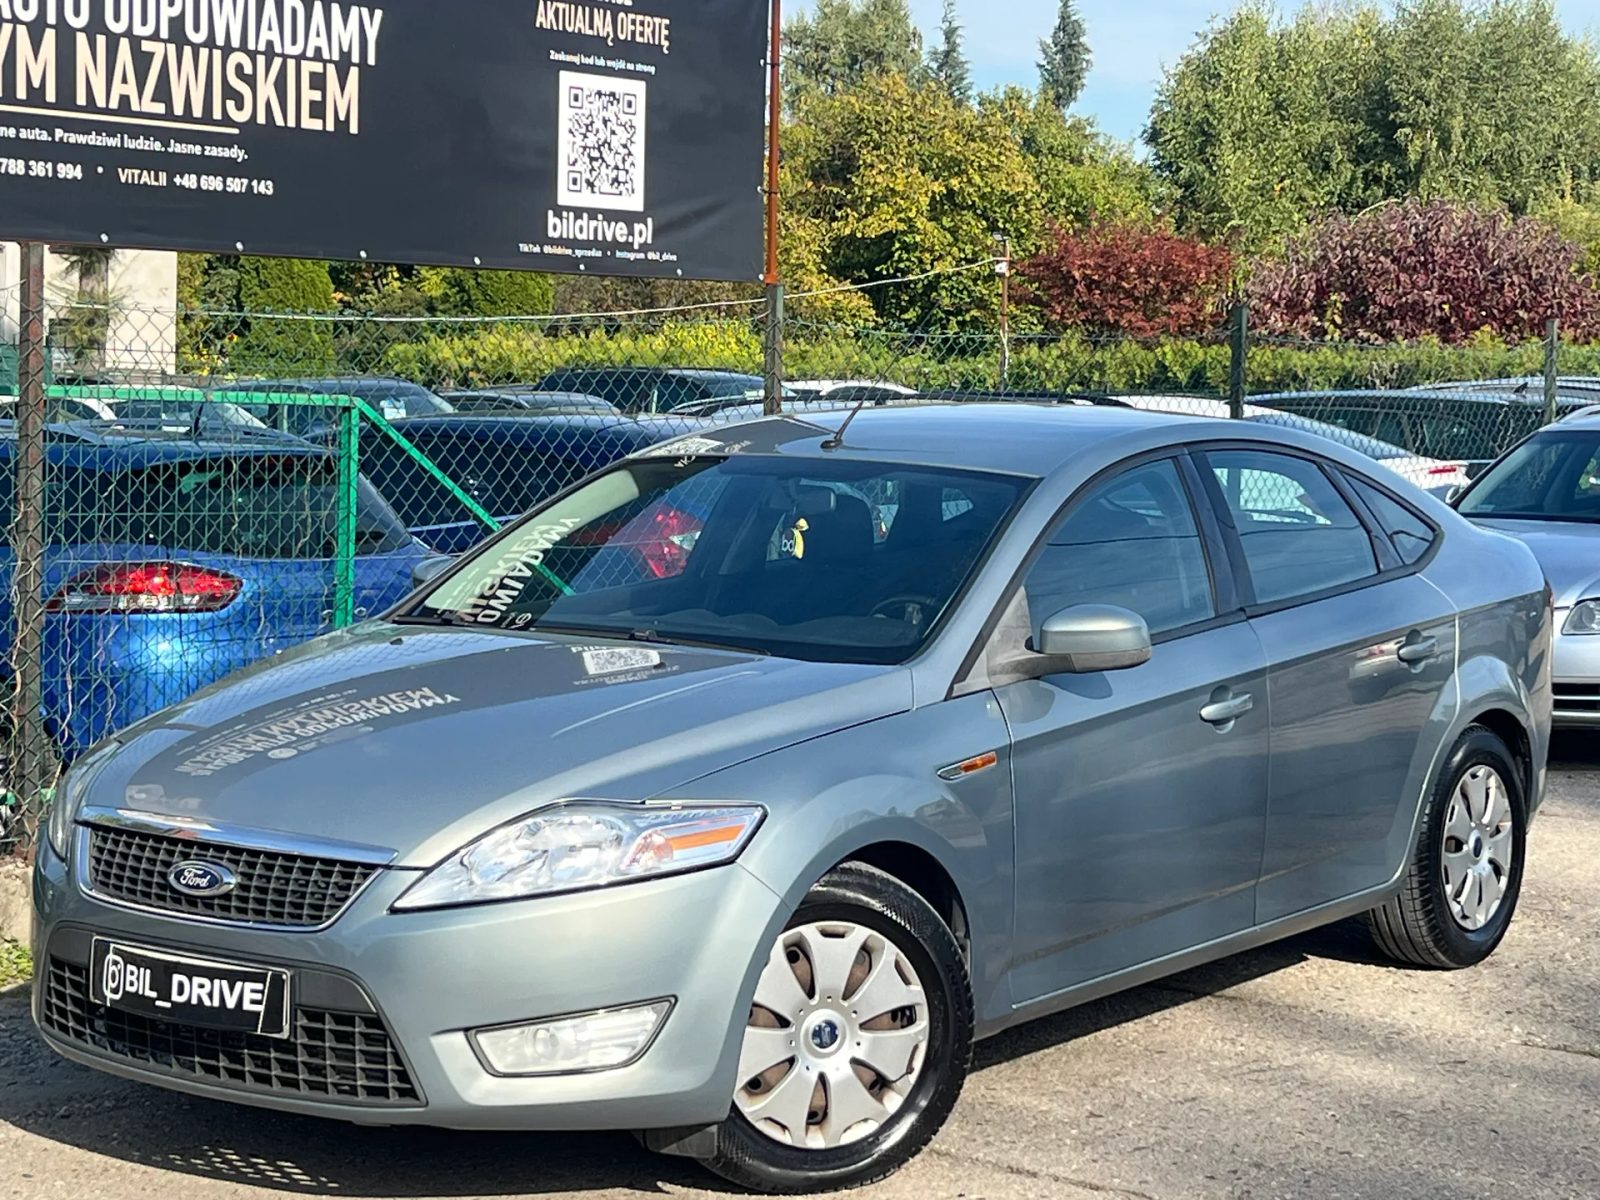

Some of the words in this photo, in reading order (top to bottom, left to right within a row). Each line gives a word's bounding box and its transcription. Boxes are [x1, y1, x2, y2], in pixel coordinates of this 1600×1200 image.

[535, 0, 614, 46] AKTUALNĄ
[617, 11, 670, 54] OFERTĘ
[76, 31, 359, 135] NAZWISKIEM
[19, 127, 53, 141] auta.
[55, 128, 121, 148] Prawdziwi
[123, 134, 166, 152] ludzie.
[167, 139, 202, 155] Jasne
[204, 144, 249, 162] zasady.
[0, 158, 26, 175] 788
[28, 160, 53, 178] 361
[56, 162, 83, 180] 994
[117, 167, 168, 187] VITALII
[173, 173, 198, 189] +48
[200, 174, 224, 192] 696
[226, 177, 249, 193] 507
[251, 179, 274, 195] 143
[547, 209, 654, 250] bildrive.pl
[179, 868, 210, 887] Ford
[125, 964, 264, 1010] BIL_DRIVE
